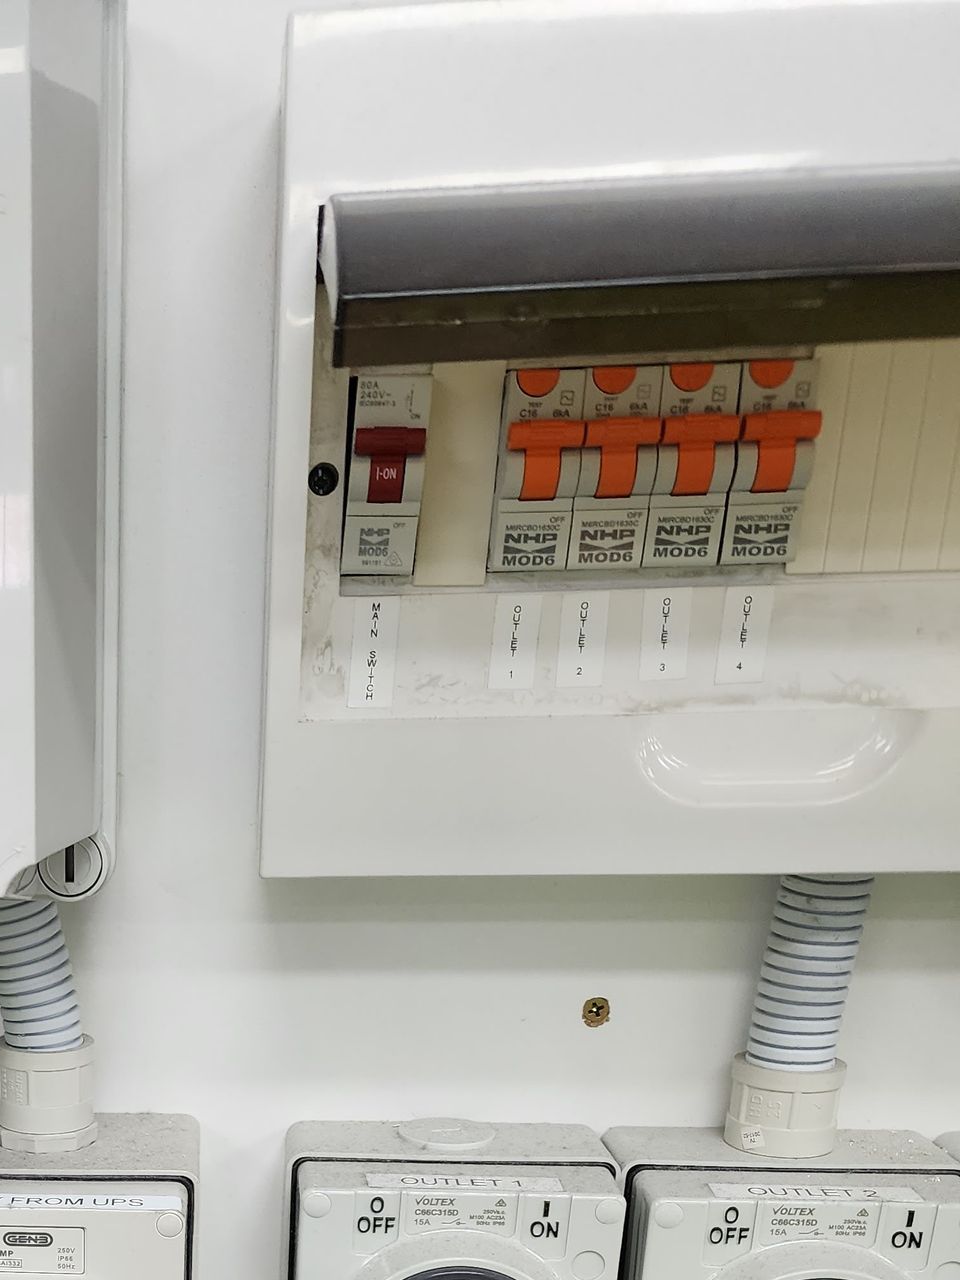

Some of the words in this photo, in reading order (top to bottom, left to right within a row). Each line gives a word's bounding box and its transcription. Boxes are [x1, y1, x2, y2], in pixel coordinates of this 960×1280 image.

[360, 528, 390, 537] NHP
[580, 529, 635, 541] NHP
[656, 525, 712, 536] NHP
[734, 523, 790, 535] NHP
[504, 533, 558, 544] NHP
[578, 551, 633, 563] MOD6
[653, 547, 708, 558] MOD6
[731, 545, 787, 557] MOD6
[502, 554, 555, 566] MOD6
[370, 602, 381, 638] MAIN
[660, 597, 671, 650] OUTLET
[740, 596, 753, 648] OUTLET
[510, 605, 522, 657] OUTLET
[577, 601, 589, 654] OUTLET
[576, 667, 582, 676] 2
[659, 663, 666, 672] 3
[736, 662, 742, 670] 4
[365, 650, 377, 700] SWITCH
[401, 1177, 502, 1188] OUTLET
[512, 1180, 522, 1188] 1
[747, 1187, 854, 1198] OUTLET
[863, 1190, 880, 1198] 2
[10, 1196, 84, 1206] FROM
[93, 1198, 144, 1207] UPS
[415, 1195, 456, 1206] VOLTEX
[772, 1204, 816, 1216] VOLTEX
[357, 1217, 396, 1234] OFF
[530, 1221, 560, 1238] ON
[5, 1234, 51, 1245] GEN3
[709, 1227, 750, 1245] OFF
[891, 1231, 924, 1249] ON
